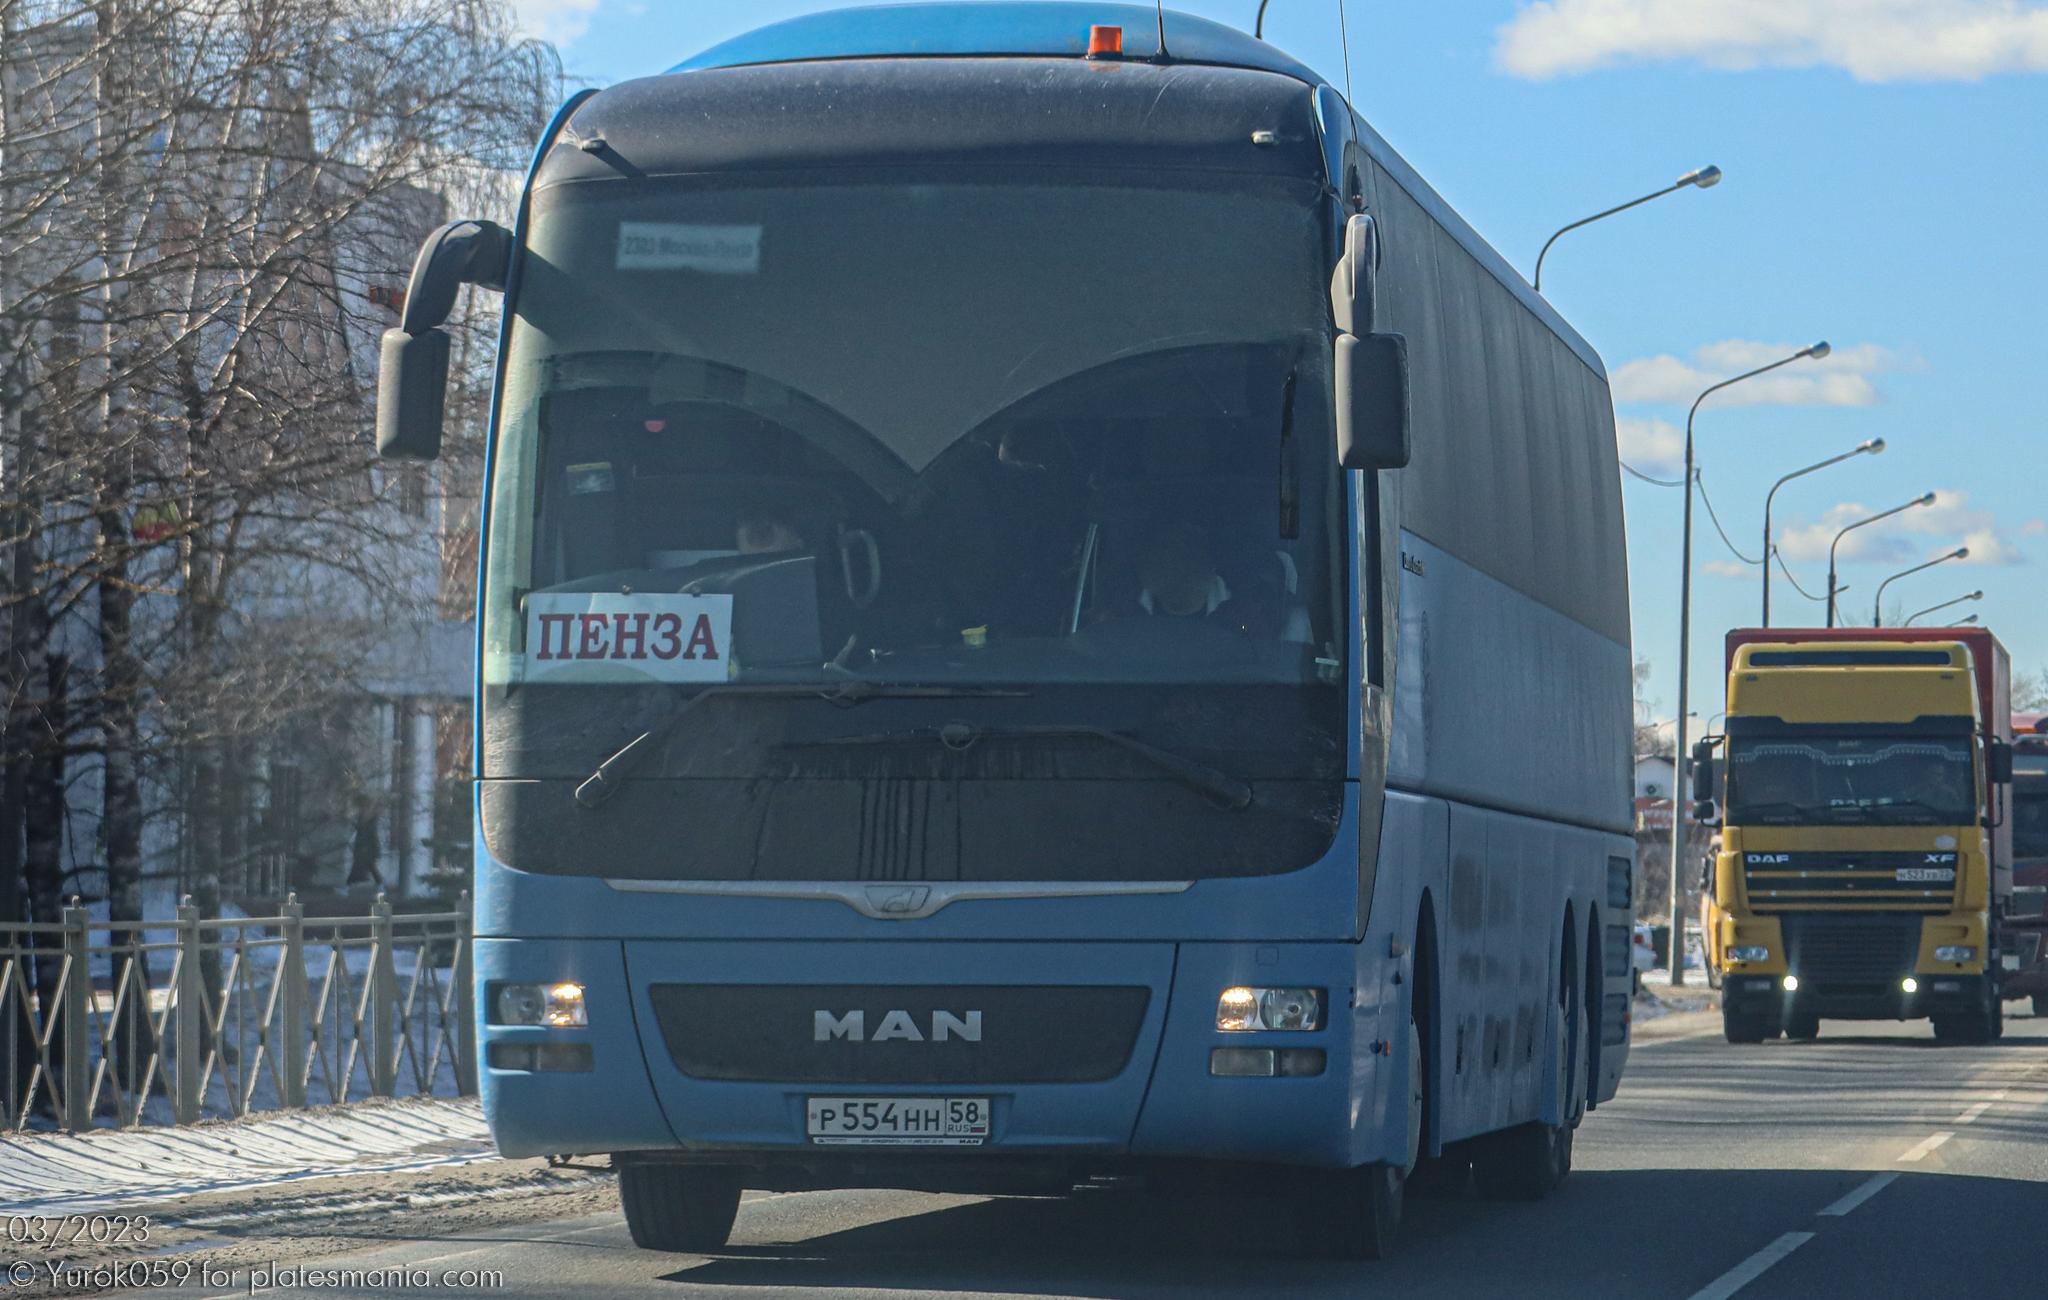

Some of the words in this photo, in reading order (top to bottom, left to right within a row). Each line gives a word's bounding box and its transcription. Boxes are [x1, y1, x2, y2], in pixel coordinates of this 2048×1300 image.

[536, 613, 719, 660] ПЕНЗА
[1747, 854, 1790, 863] DAF
[1924, 854, 1956, 863] XF
[814, 1010, 982, 1041] MAN
[950, 1102, 978, 1123] 58
[947, 1124, 969, 1133] RUS
